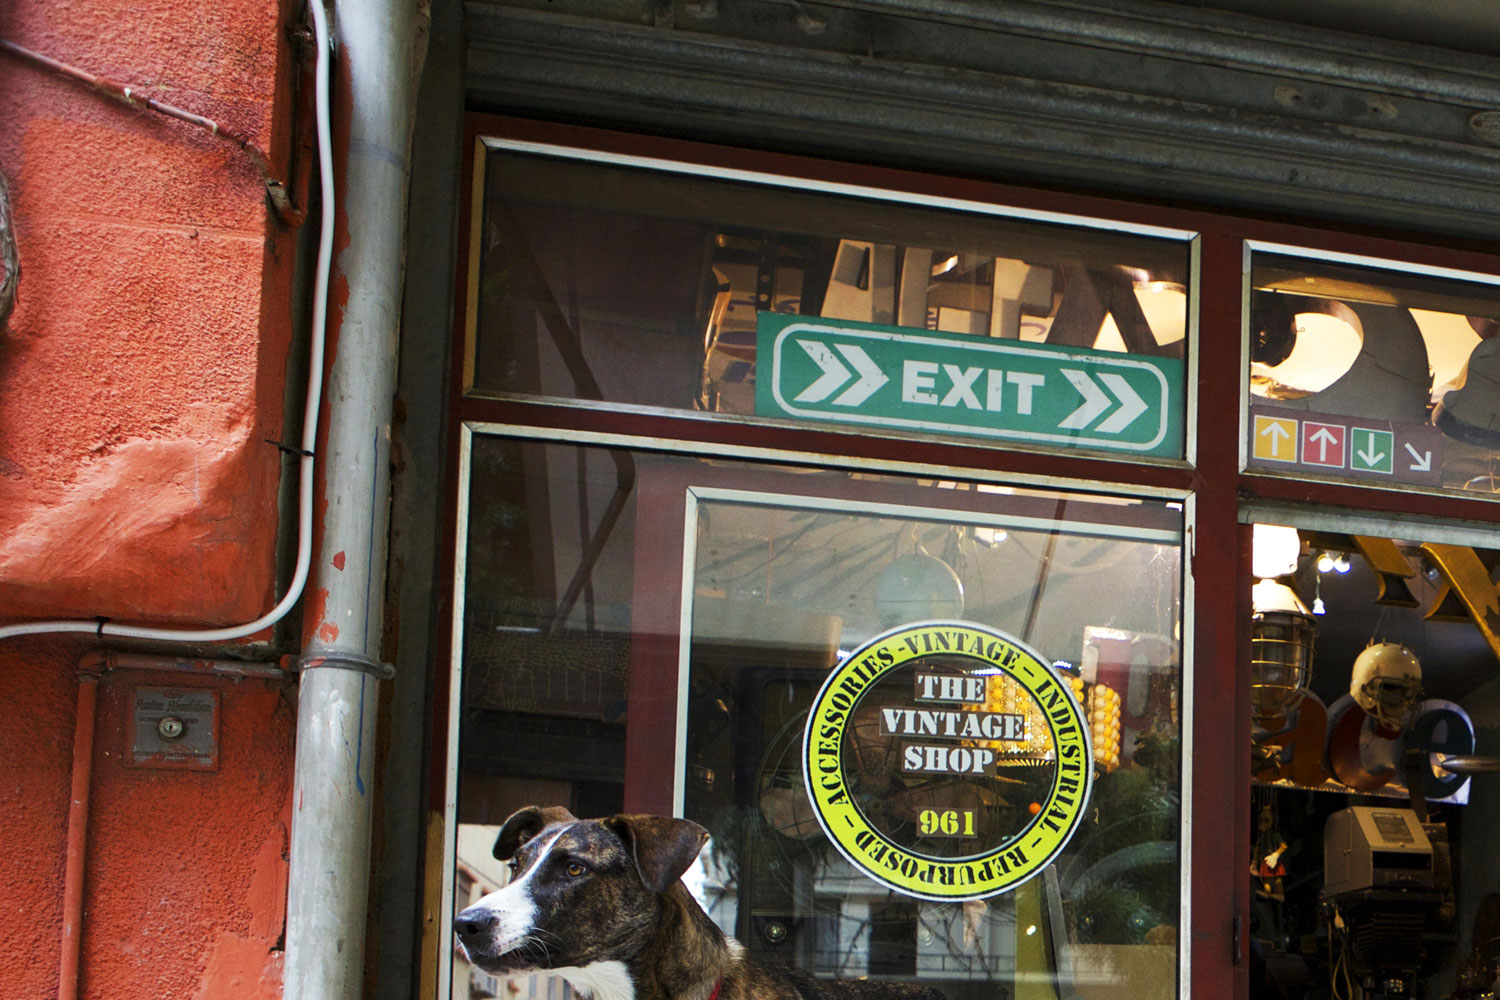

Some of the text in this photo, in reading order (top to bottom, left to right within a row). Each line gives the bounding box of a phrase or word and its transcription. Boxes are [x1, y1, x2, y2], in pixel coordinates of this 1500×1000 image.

[901, 359, 1045, 415] EXIT
[917, 674, 984, 701] THE
[882, 708, 1024, 740] VINTAGE
[818, 632, 1082, 887] VINTAGE INDUSTRIAL REPURPOSED ACCESSORIES
[905, 745, 993, 774] SHOP
[920, 809, 974, 836] 961
